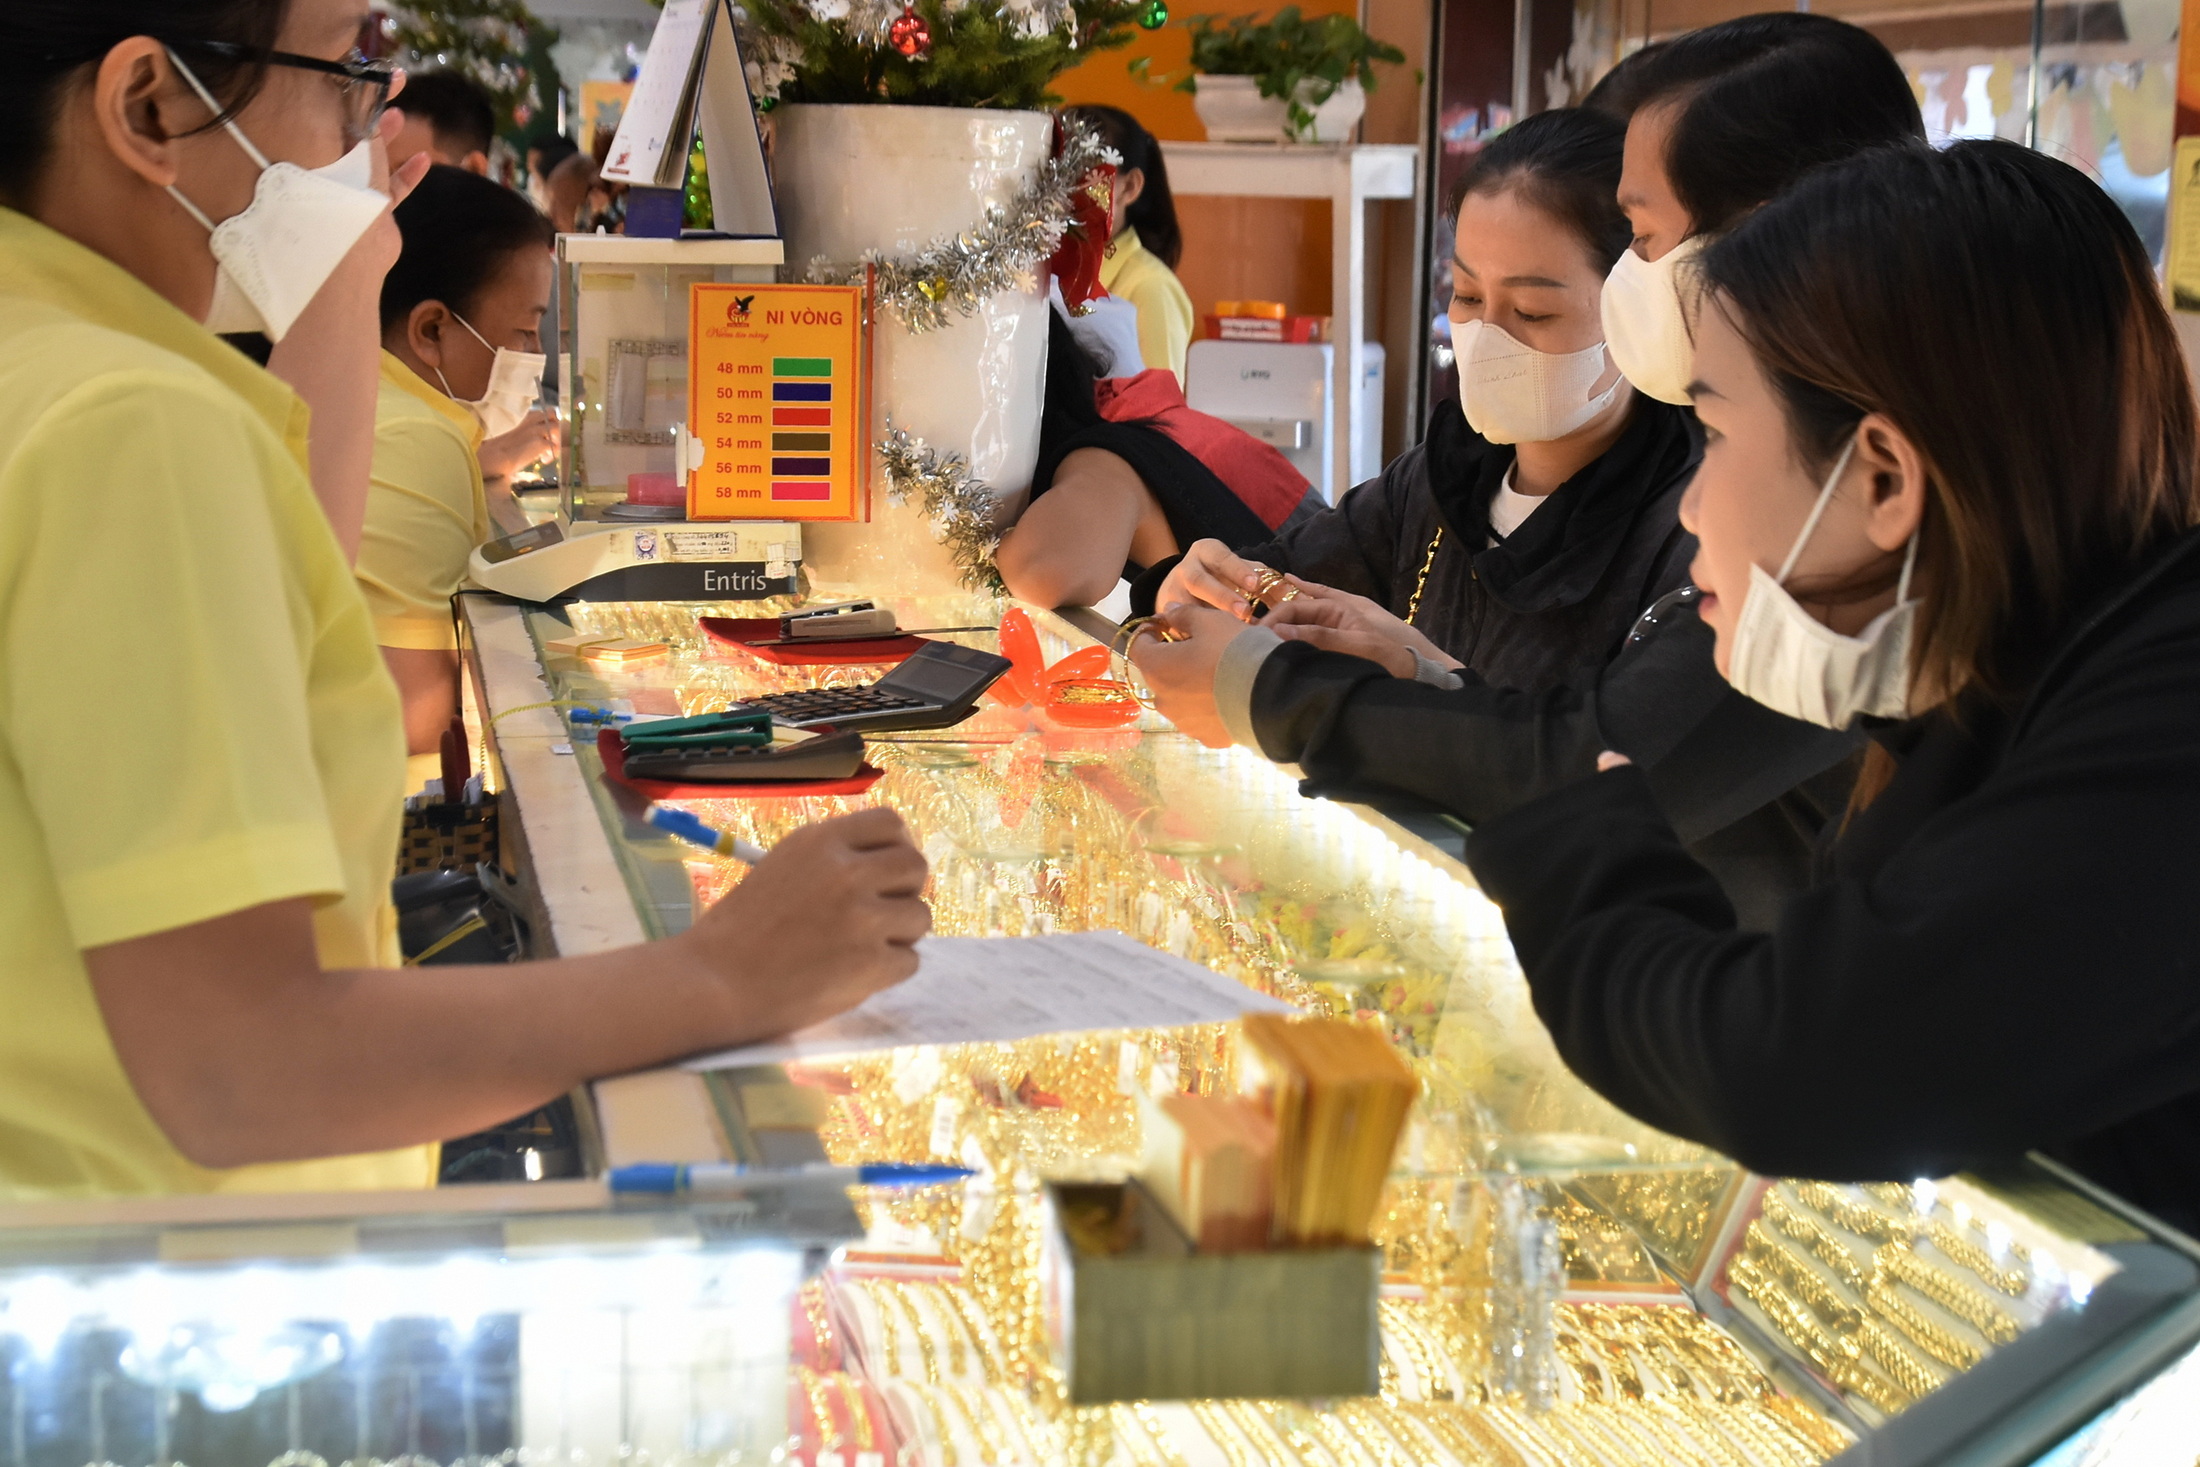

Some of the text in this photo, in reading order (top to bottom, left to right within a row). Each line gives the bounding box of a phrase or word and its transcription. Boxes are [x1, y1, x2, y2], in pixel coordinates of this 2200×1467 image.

[766, 307, 843, 325] NI VÒNG
[717, 362, 763, 374] 48 mm
[716, 387, 763, 399] 50 mm
[716, 412, 763, 424] 52 mm
[716, 437, 762, 449] 54 mm
[716, 462, 762, 474] 56 mm
[715, 487, 762, 498] 58 mm
[704, 569, 767, 591] Entris
